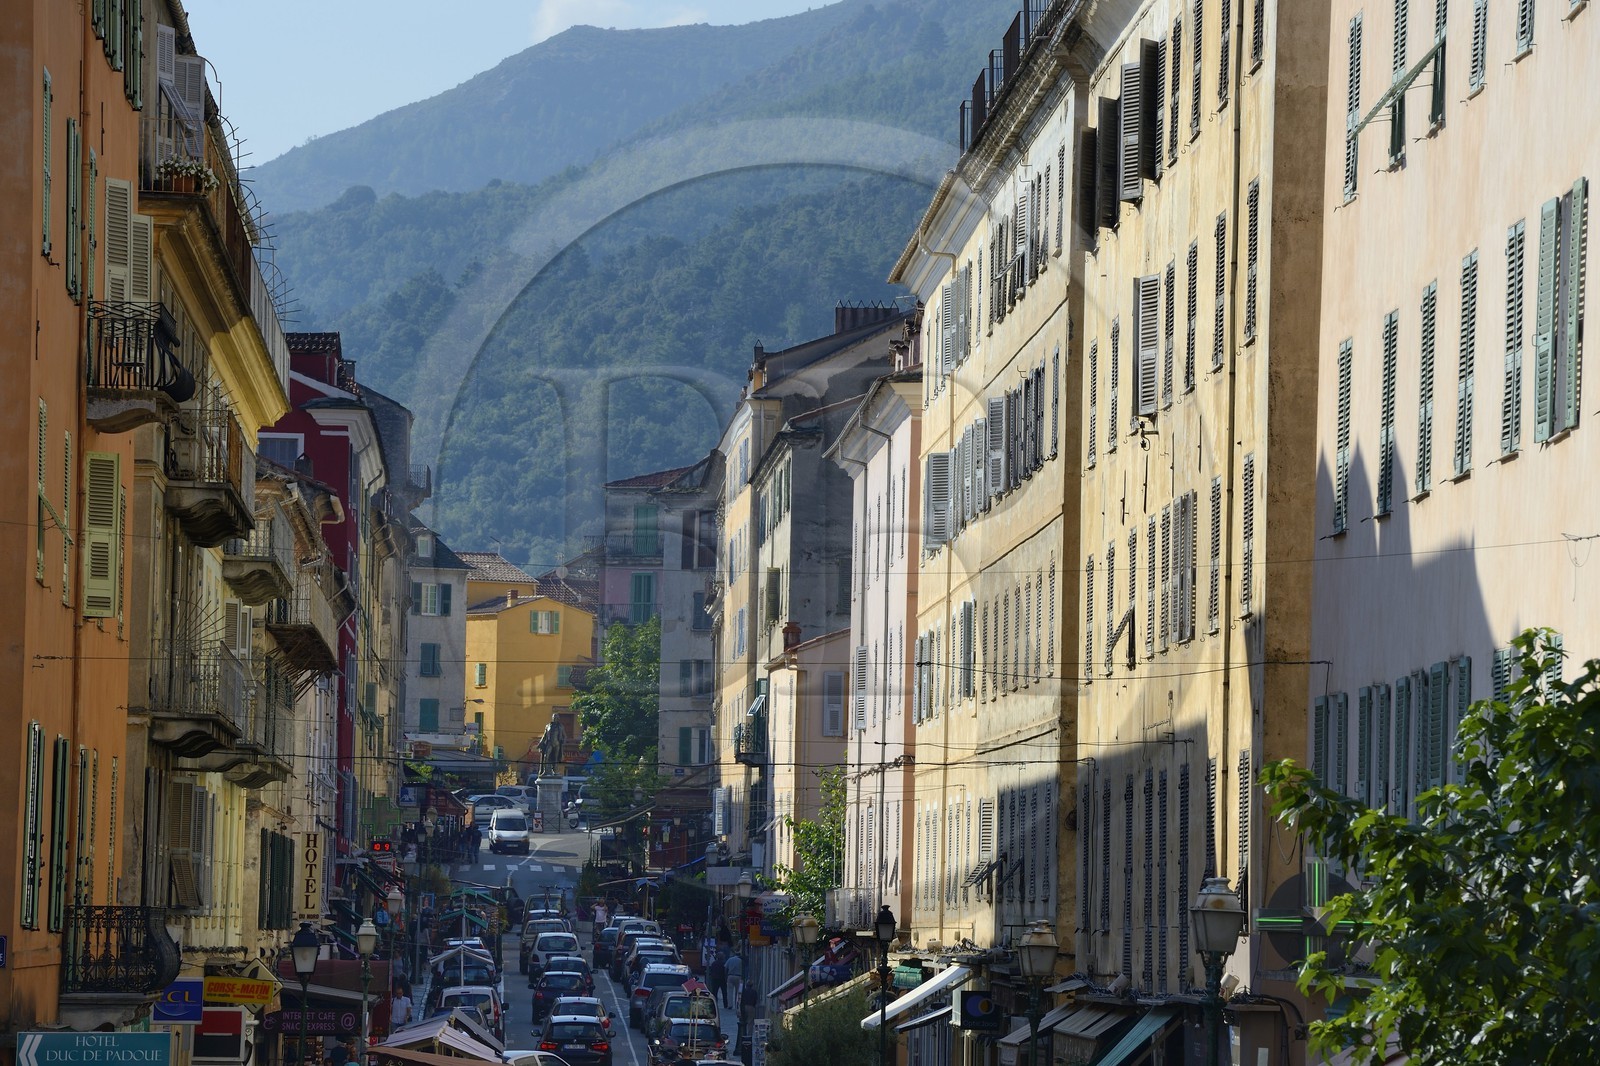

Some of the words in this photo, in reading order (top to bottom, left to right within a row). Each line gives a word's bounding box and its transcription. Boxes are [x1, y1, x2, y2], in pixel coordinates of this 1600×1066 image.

[304, 833, 318, 910] HOTEL
[282, 1011, 315, 1020] INTERET
[318, 1011, 336, 1020] CAFE
[281, 1022, 304, 1031] SNAC
[306, 1022, 336, 1031] EXPRESS
[46, 1049, 79, 1062] DUC
[83, 1049, 102, 1062] DE
[106, 1049, 162, 1062] PADOUE
